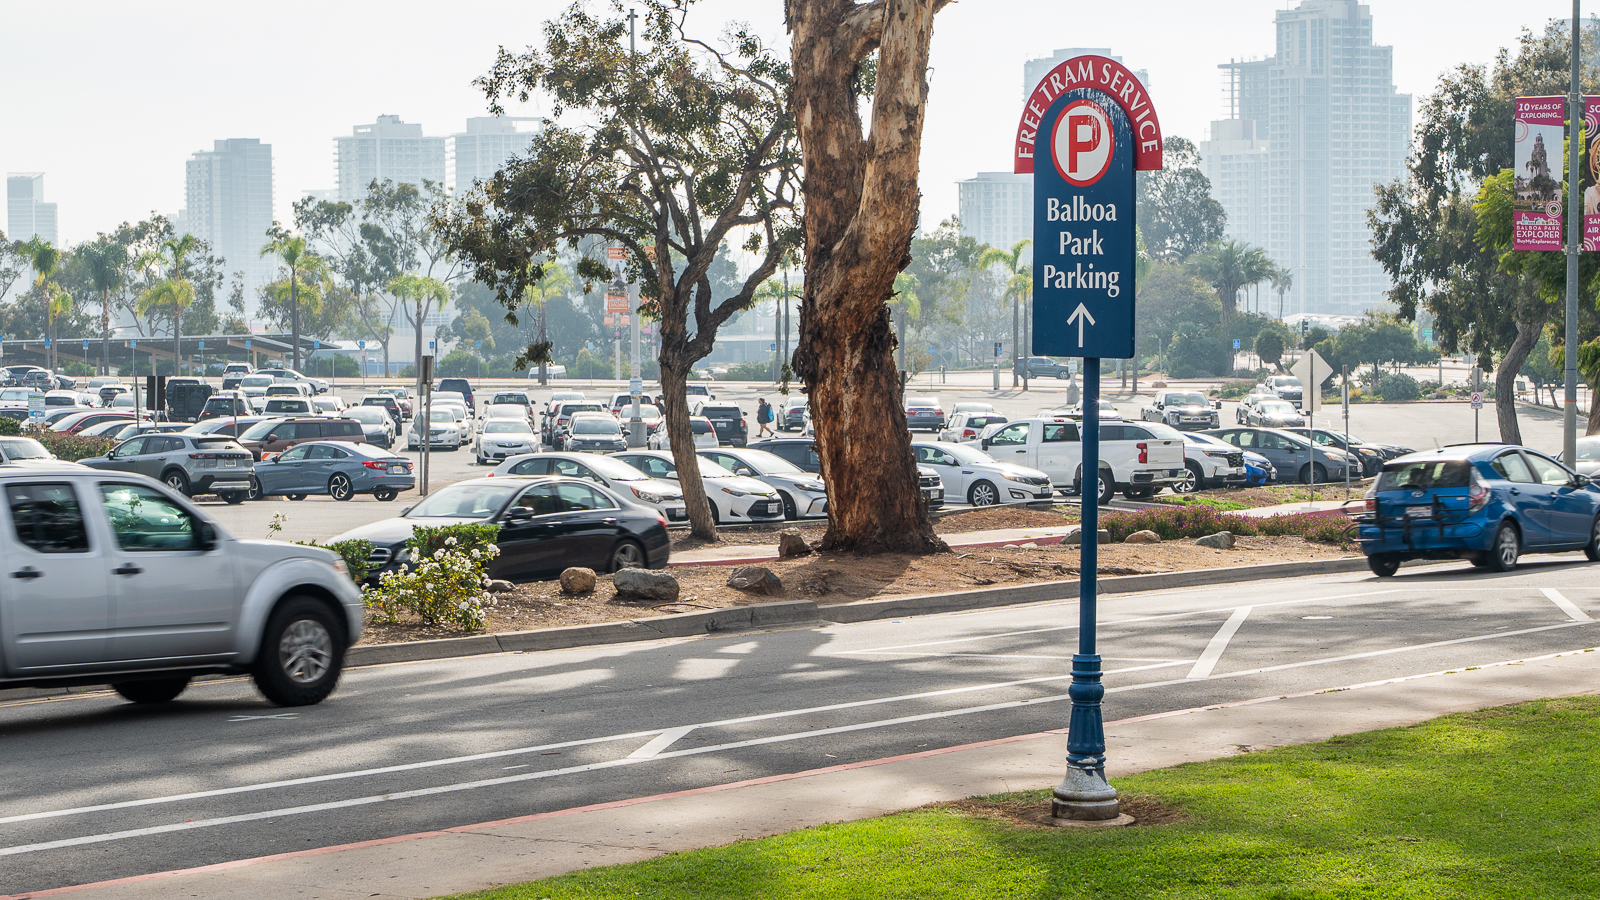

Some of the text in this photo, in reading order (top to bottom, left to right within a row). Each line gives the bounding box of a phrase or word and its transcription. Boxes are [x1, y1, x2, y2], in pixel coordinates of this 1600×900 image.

[1018, 60, 1158, 158] FREE TRAM SERVICE
[1518, 103, 1530, 111] 10
[1068, 115, 1101, 173] P
[1047, 195, 1117, 221] Balboa
[1059, 229, 1104, 255] Park
[1043, 263, 1120, 298] Parking
